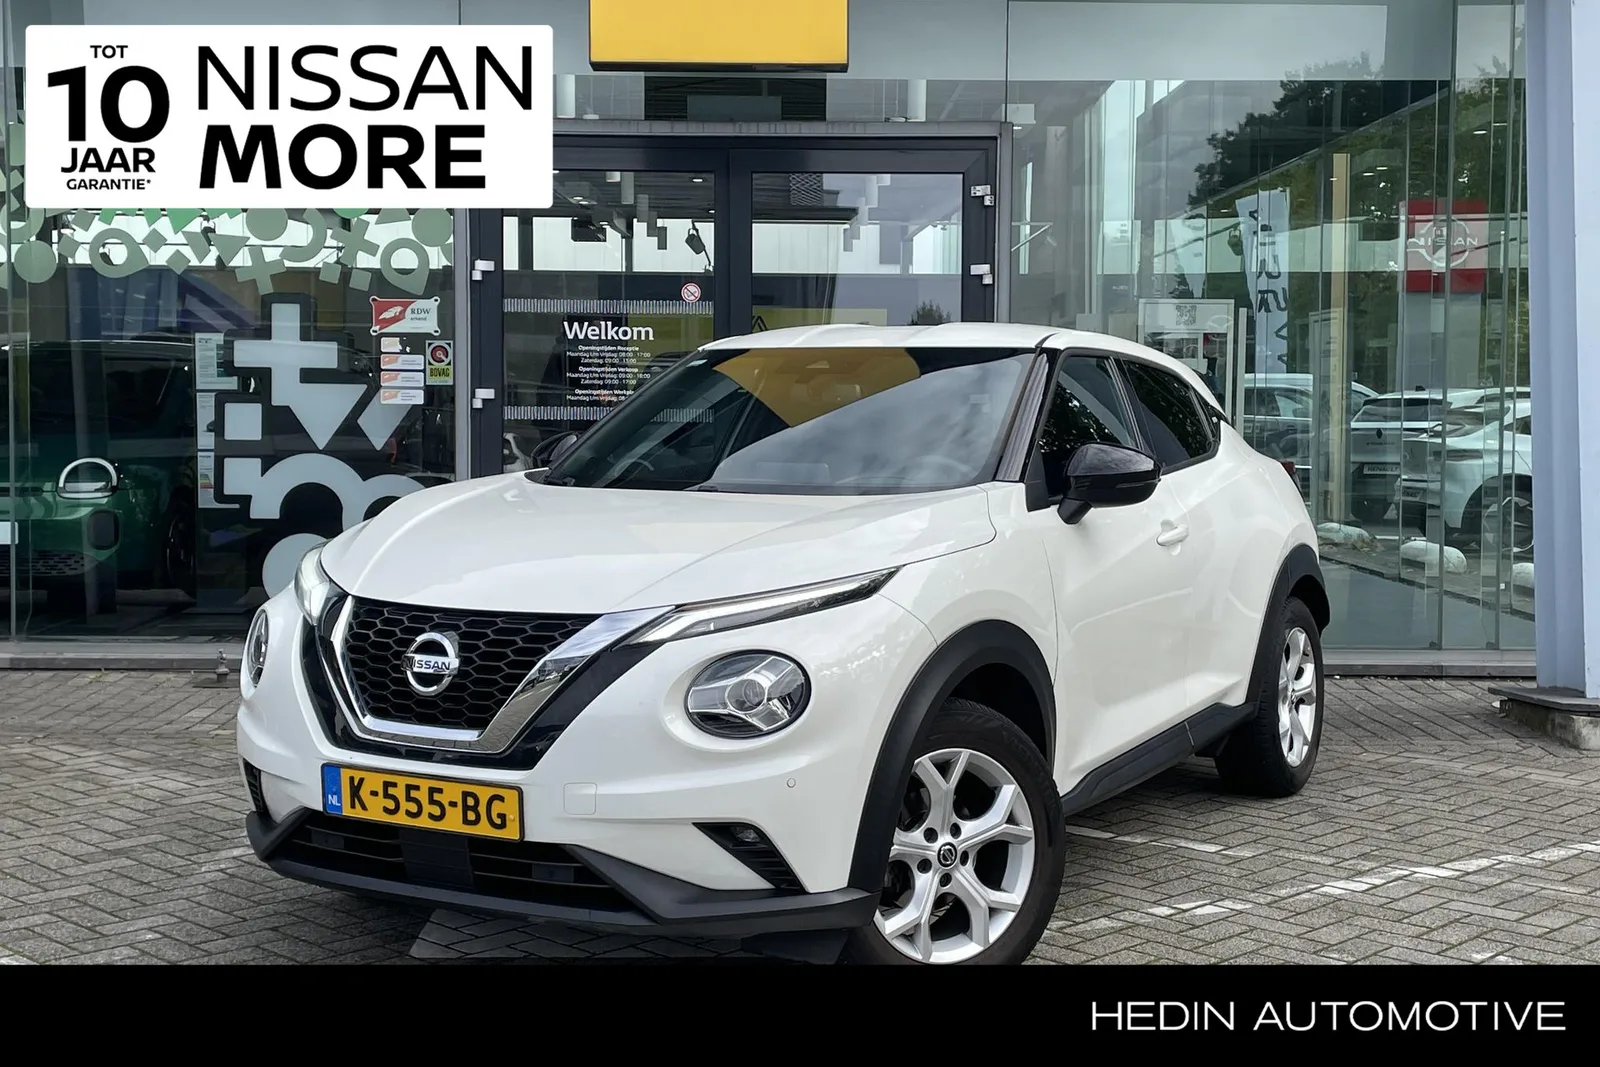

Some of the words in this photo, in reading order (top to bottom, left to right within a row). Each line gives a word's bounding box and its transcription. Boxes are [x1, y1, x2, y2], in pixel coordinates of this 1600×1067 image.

[410, 307, 431, 315] RDW
[563, 321, 654, 341] Welkom
[430, 367, 450, 377] BOVAG
[404, 656, 450, 671] NISSAN
[328, 794, 341, 807] NL
[348, 775, 507, 830] K-555-BG
